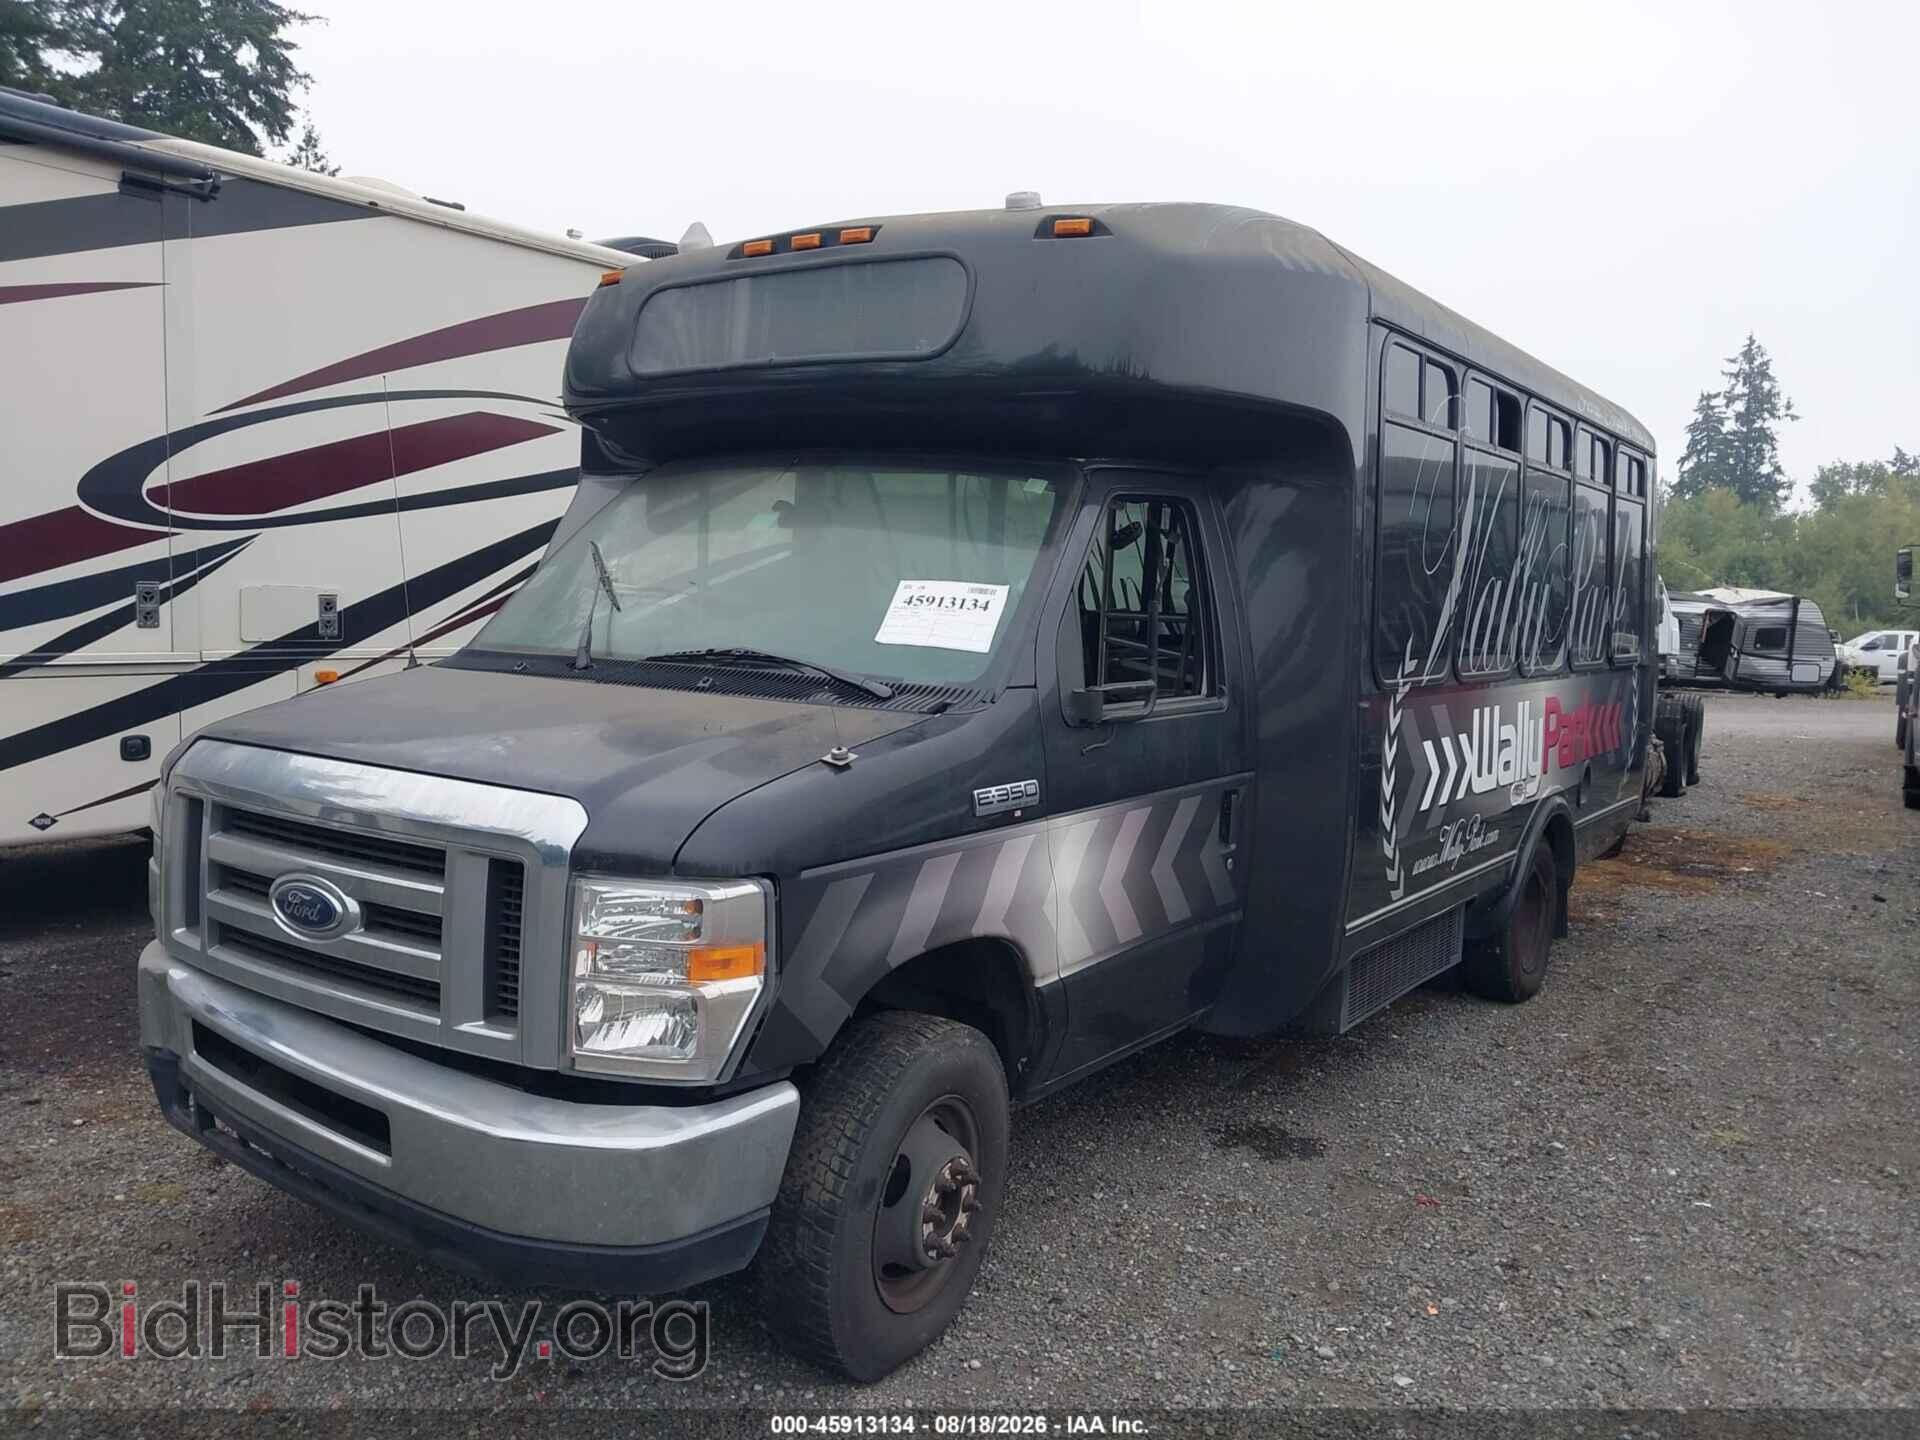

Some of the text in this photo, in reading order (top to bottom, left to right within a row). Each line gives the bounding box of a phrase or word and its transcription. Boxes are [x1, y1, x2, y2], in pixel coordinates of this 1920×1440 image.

[903, 594, 990, 612] 45913134
[1471, 688, 1599, 799] WallyPark
[283, 889, 322, 921] Ford
